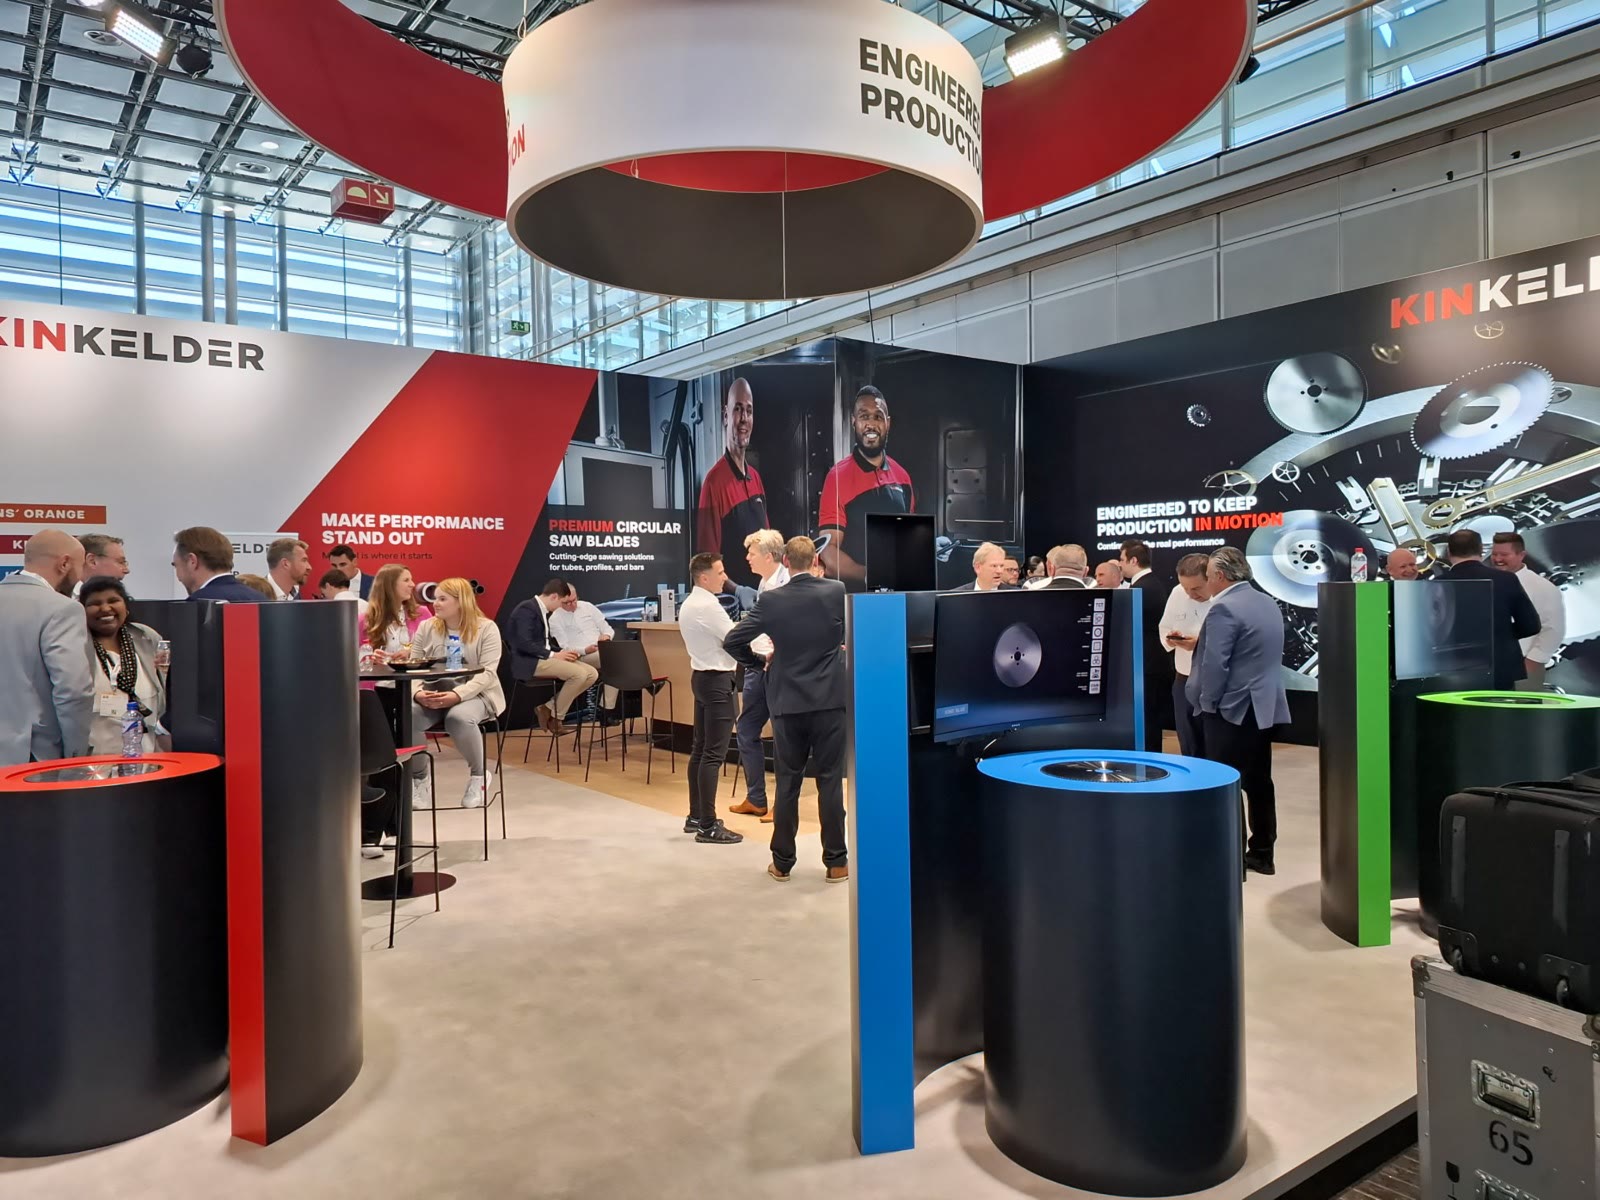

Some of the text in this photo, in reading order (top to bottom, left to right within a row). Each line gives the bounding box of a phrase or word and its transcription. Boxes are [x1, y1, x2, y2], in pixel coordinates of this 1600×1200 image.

[23, 508, 86, 520] ORANGE
[1097, 495, 1258, 521] ENGINEERED TO KEEP
[321, 512, 505, 531] MAKE PERFORMANCE
[549, 519, 682, 535] PREMIUM CIRCULAR
[1097, 511, 1285, 537] PRODUCTION IN MOTION
[322, 530, 425, 546] STAND OUT
[549, 534, 640, 548] SAW BLADES
[1156, 538, 1171, 549] real
[1172, 538, 1225, 549] performance
[361, 551, 369, 560] is
[371, 551, 398, 560] where
[400, 551, 406, 560] it
[408, 551, 433, 560] starts
[549, 552, 655, 562] Cutting-edge sawing solutions
[549, 563, 645, 572] for tubes, profiles, and bars
[1489, 1120, 1534, 1166] 65
